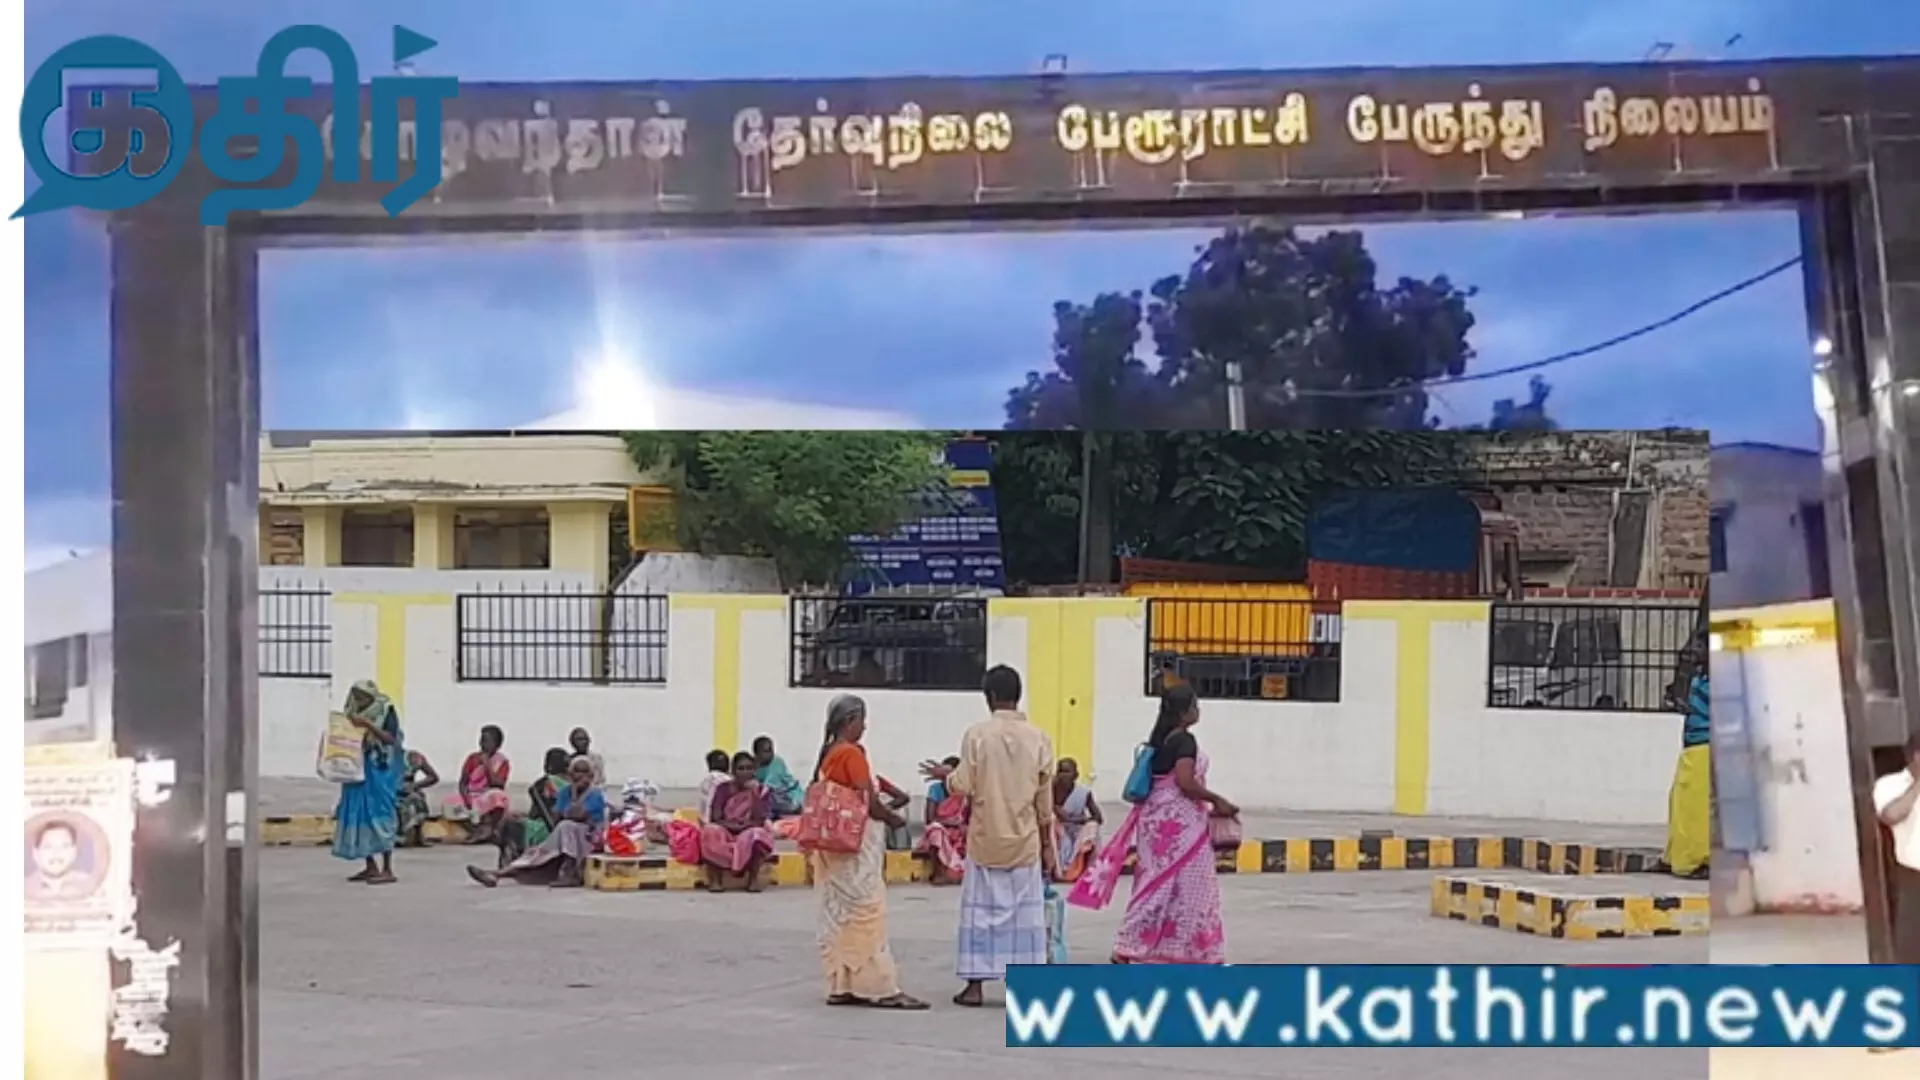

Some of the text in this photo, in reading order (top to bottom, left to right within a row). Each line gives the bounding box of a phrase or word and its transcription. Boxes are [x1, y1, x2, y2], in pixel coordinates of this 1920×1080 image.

[732, 97, 1013, 170] தேர்வுநிலை
[1057, 92, 1310, 164] பேரூராட்சி
[1347, 82, 1544, 161] பேருந்து
[1584, 76, 1776, 152] நிலையம்
